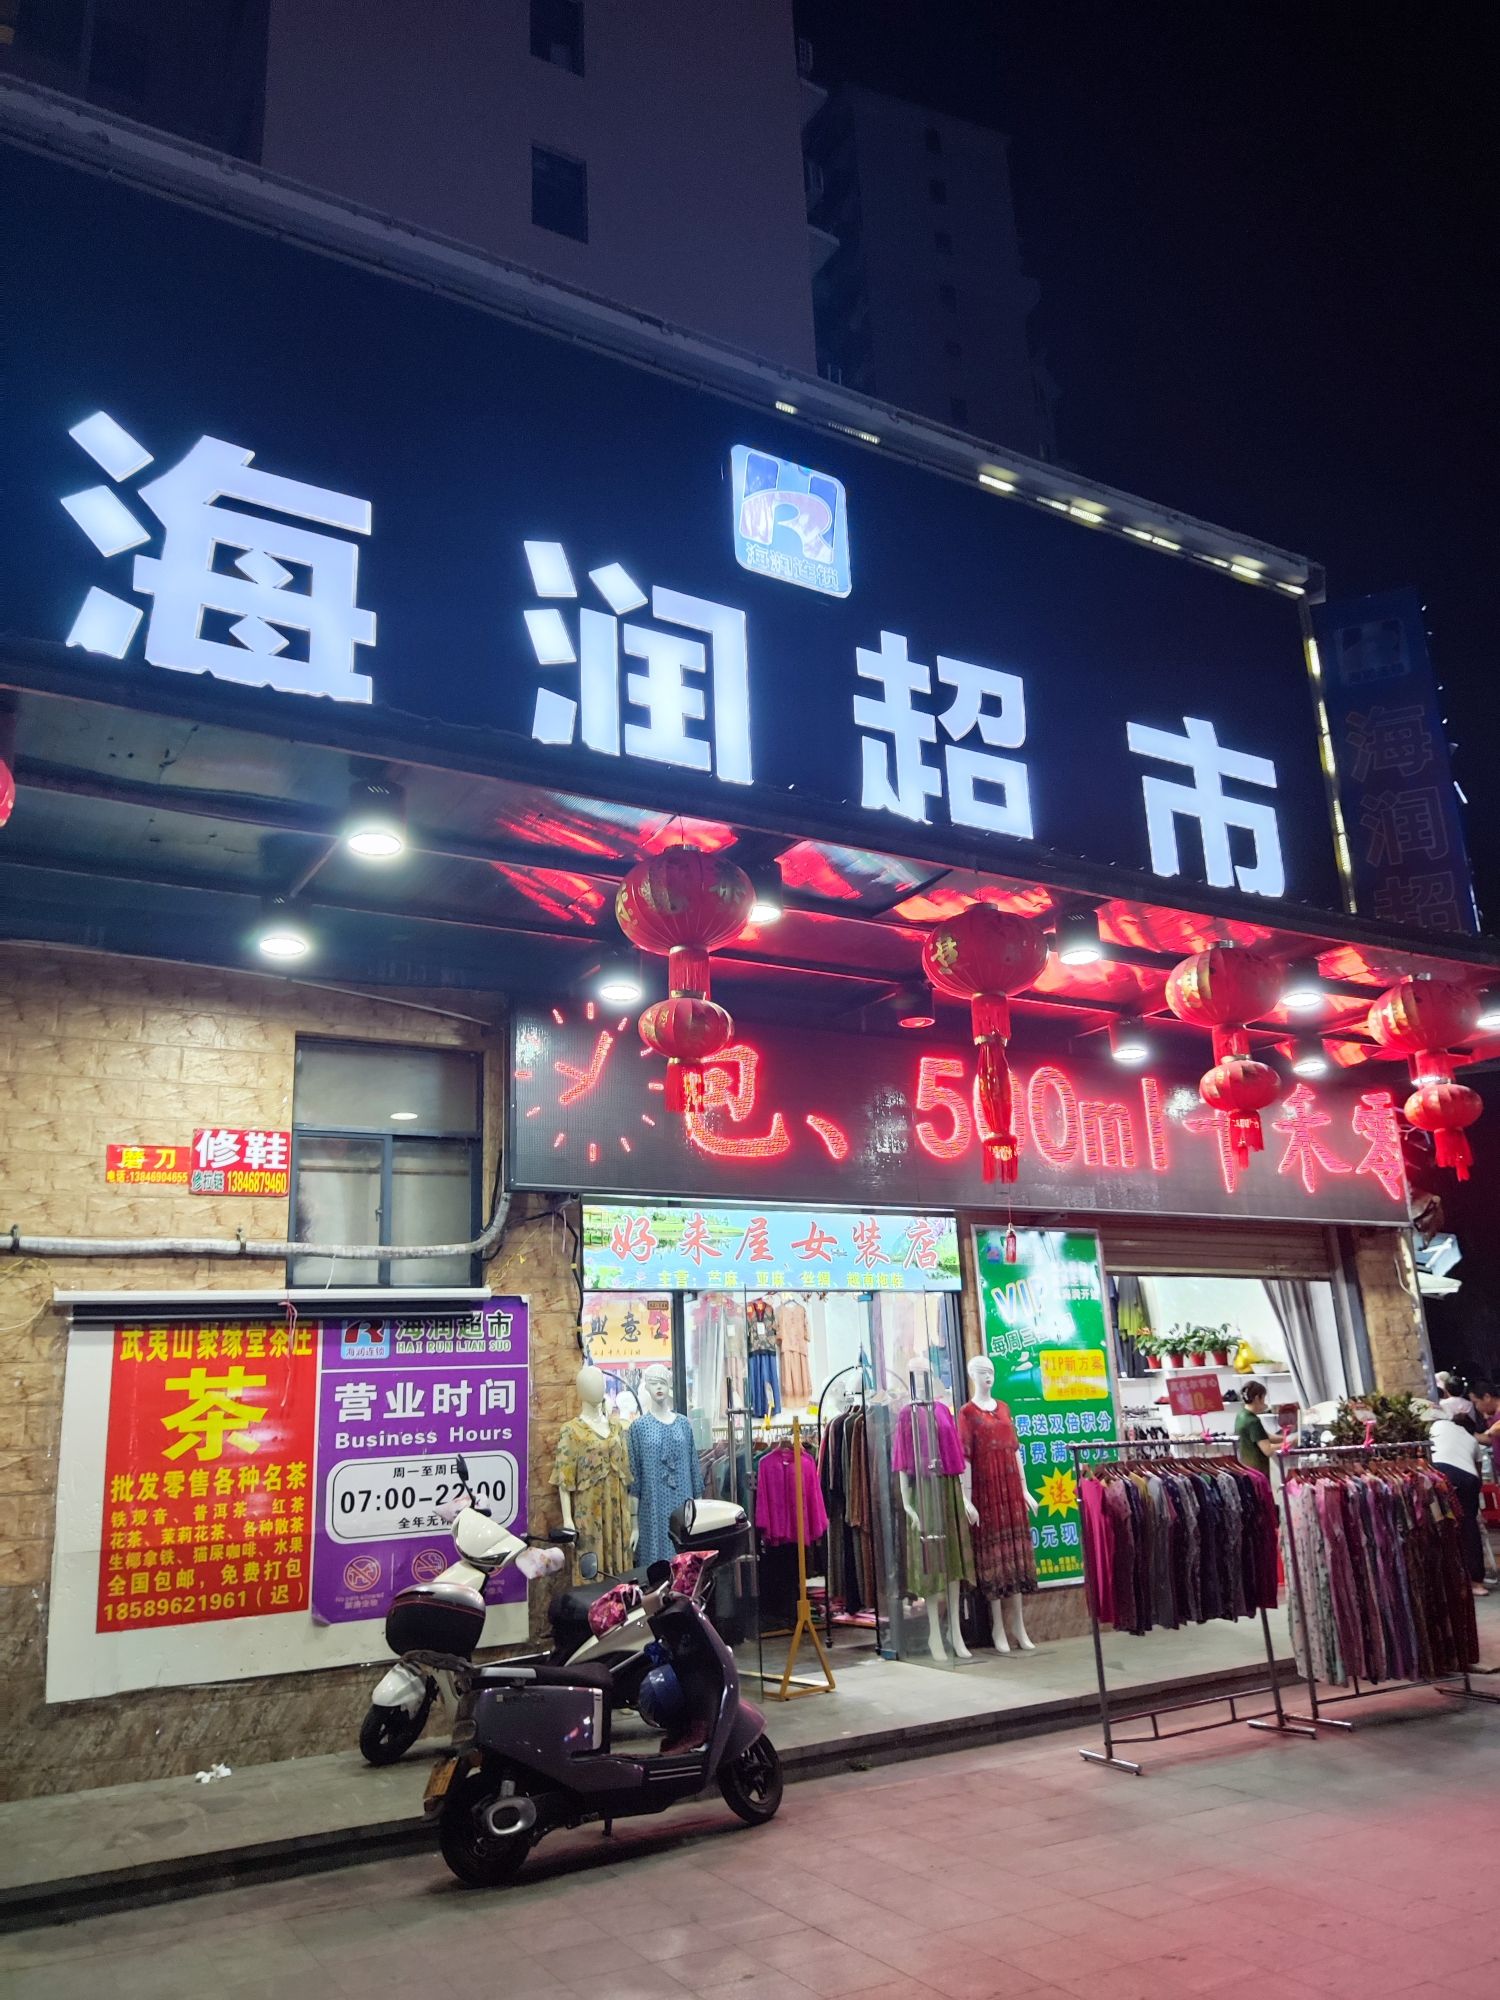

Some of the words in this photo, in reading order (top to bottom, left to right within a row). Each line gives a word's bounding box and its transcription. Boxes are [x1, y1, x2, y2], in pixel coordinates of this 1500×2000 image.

[60, 410, 1286, 898] 海润超市
[121, 1146, 176, 1169] 磨刀
[195, 1130, 288, 1169] 修鞋
[227, 1171, 287, 1193] 13846879460
[610, 1212, 939, 1270] 好来屋女装店
[395, 1309, 514, 1341] 海润超市
[396, 1341, 423, 1354] HAI
[427, 1341, 453, 1353] RUN
[456, 1340, 486, 1353] LIAN
[489, 1339, 511, 1352] SUO
[160, 1366, 268, 1461] 茶
[334, 1379, 516, 1423] 营业时间
[335, 1430, 438, 1449] Business
[449, 1426, 513, 1443] Hours
[110, 1461, 307, 1503] 批发零售各种名茶
[110, 1496, 305, 1528] 铁观音、普洱茶、红茶
[110, 1516, 304, 1550] 花茶、茉莉花茶、各种散茶
[109, 1536, 303, 1571] 生椰拿铁、猫屎咖啡、水果
